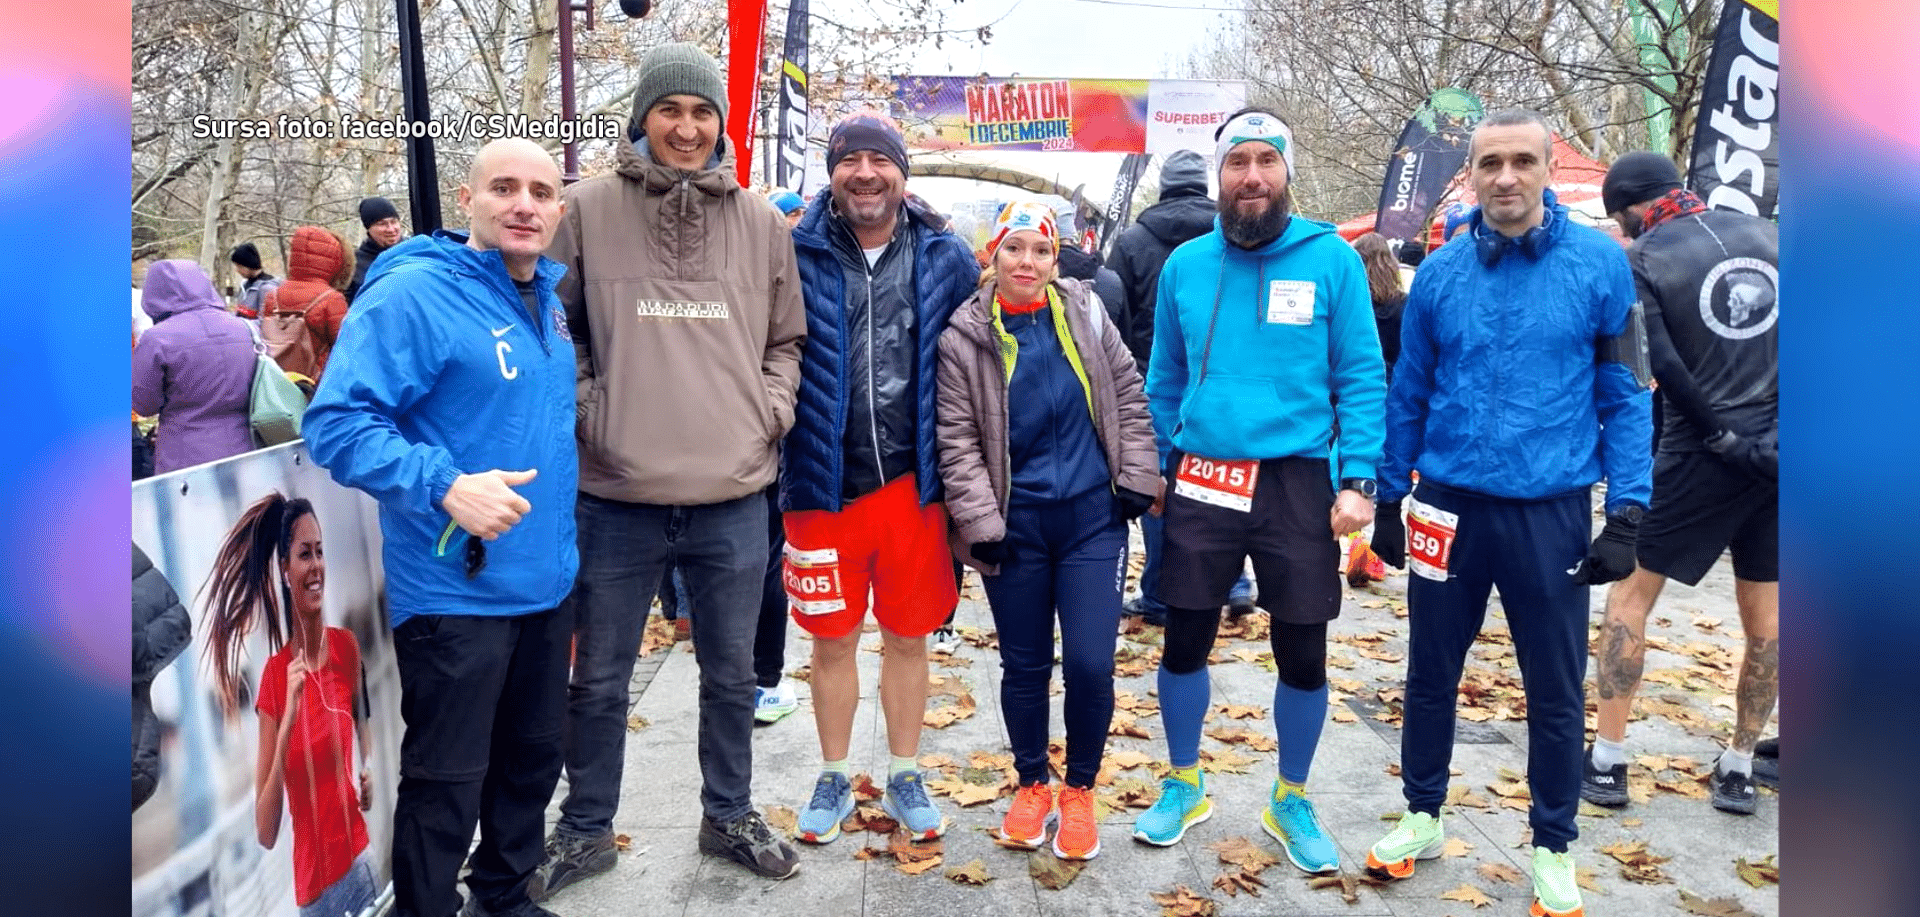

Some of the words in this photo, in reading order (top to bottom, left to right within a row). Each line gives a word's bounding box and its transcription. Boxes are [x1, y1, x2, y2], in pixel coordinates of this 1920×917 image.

[966, 80, 1071, 123] MARATON
[1154, 111, 1226, 125] SUPERBET
[978, 119, 1073, 143] DECEMBRIE
[1042, 137, 1073, 150] 2024
[496, 341, 518, 380] C
[1189, 457, 1246, 487] 2015
[787, 570, 832, 594] 2005
